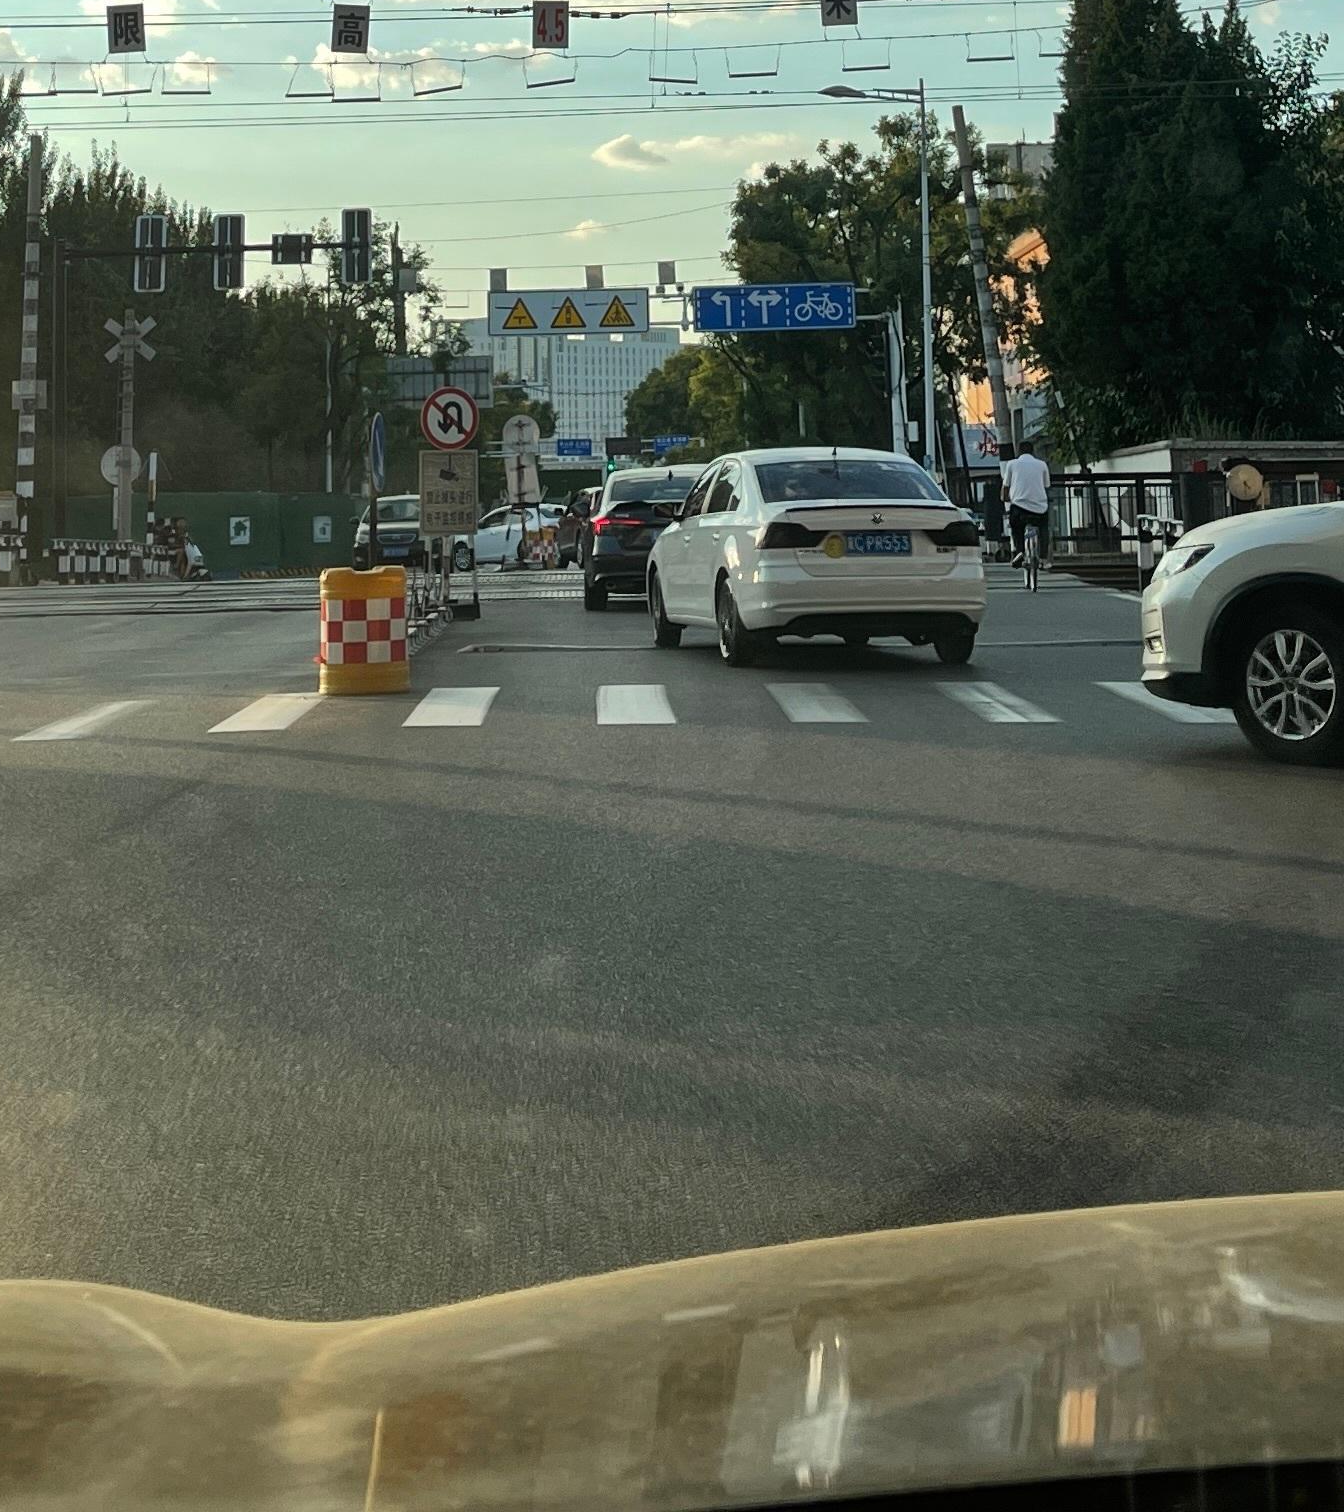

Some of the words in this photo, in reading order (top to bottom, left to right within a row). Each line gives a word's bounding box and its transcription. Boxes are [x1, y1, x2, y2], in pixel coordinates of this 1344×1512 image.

[113, 11, 141, 47] 限
[337, 12, 366, 47] 高
[537, 8, 565, 42] 4.5
